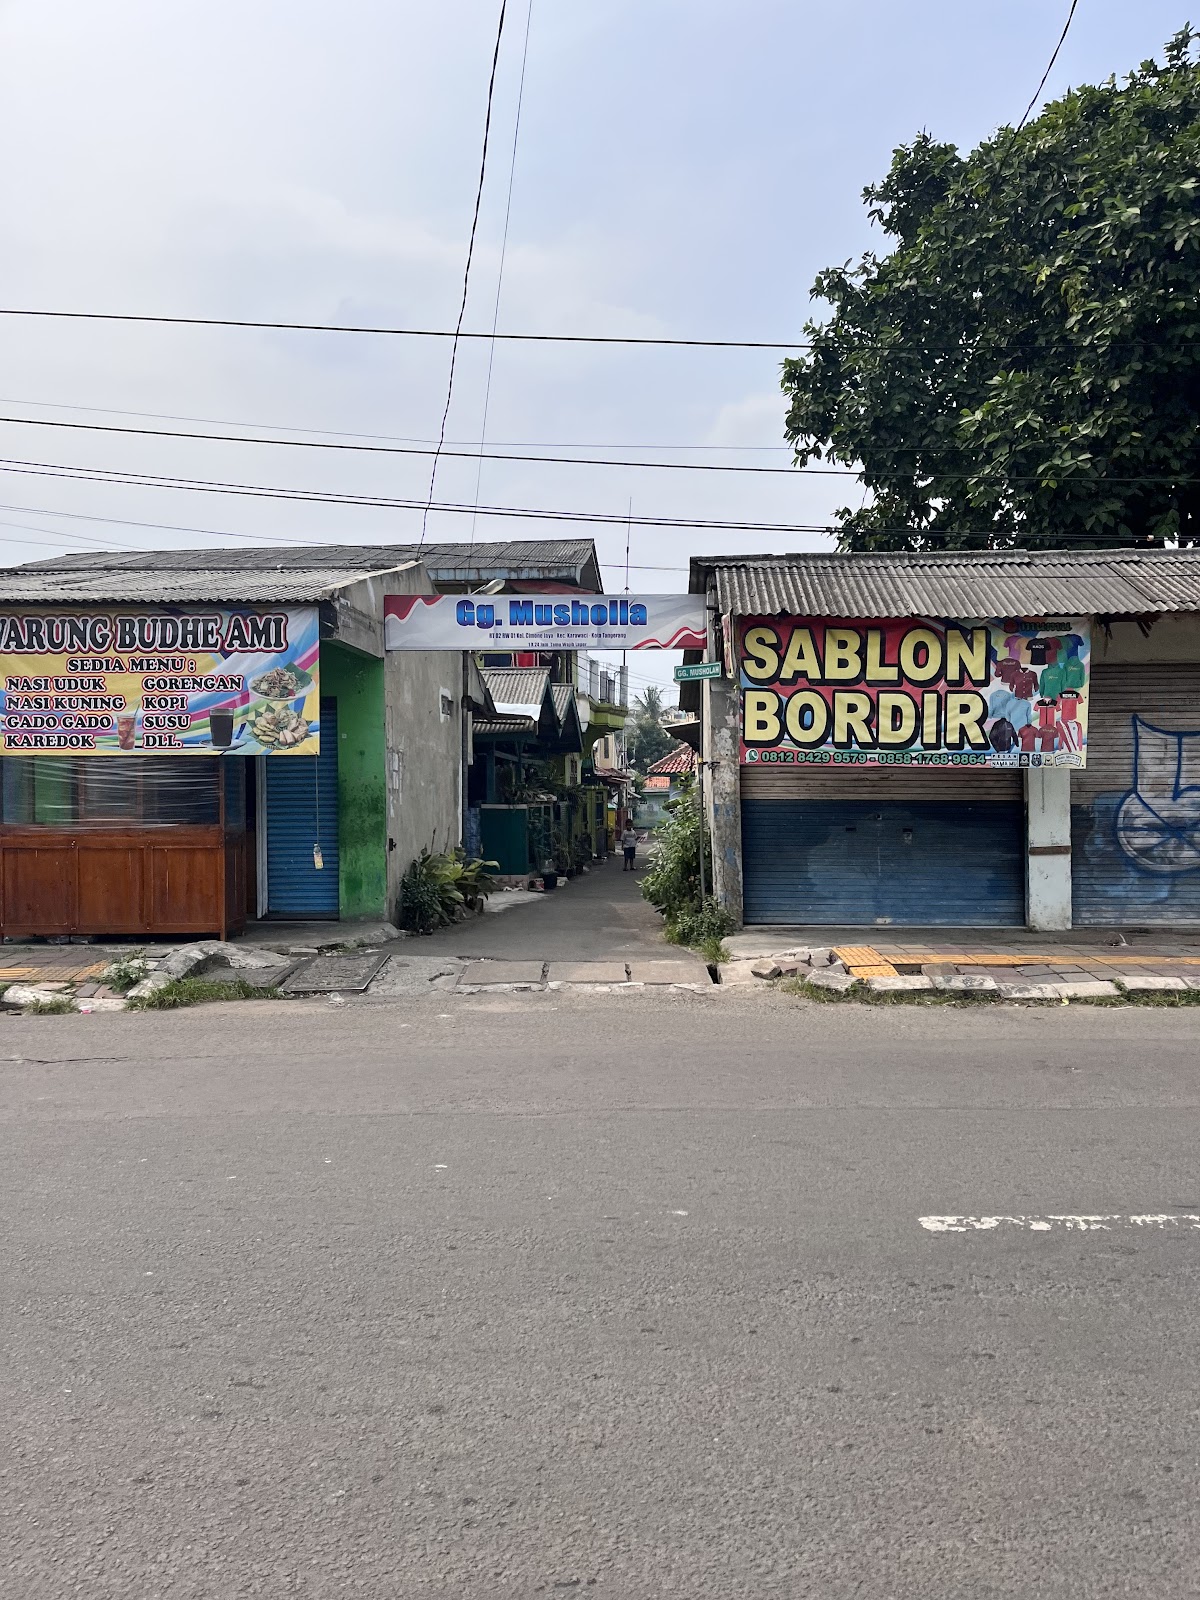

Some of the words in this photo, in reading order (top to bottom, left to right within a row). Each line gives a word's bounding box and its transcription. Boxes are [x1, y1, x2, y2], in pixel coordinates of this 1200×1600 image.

[455, 599, 503, 629] Gg.
[508, 599, 648, 626] Musholla
[116, 617, 221, 650] BUDHE
[225, 616, 285, 649] AMI
[742, 626, 988, 682] SABLON
[67, 658, 126, 672] SEDIA
[129, 658, 185, 672] MENU
[677, 670, 689, 678] GG.
[7, 678, 50, 691] NASI
[53, 678, 105, 691] UDUK
[143, 677, 242, 691] GORENGAN
[6, 697, 50, 710] NASI
[53, 697, 124, 710] KUNING
[143, 696, 187, 709] KOPI
[6, 715, 58, 729] GADO
[61, 715, 112, 729] GADO
[143, 715, 190, 728] SUSU
[742, 689, 987, 745] BORDIR
[6, 734, 94, 748] KAREDOK
[144, 734, 182, 748] DLL.
[761, 751, 794, 763] 0812
[797, 751, 830, 764] 8429
[833, 751, 867, 764] 9579
[878, 752, 912, 765] 0858
[916, 752, 949, 765] 1768
[952, 752, 986, 765] 9864
